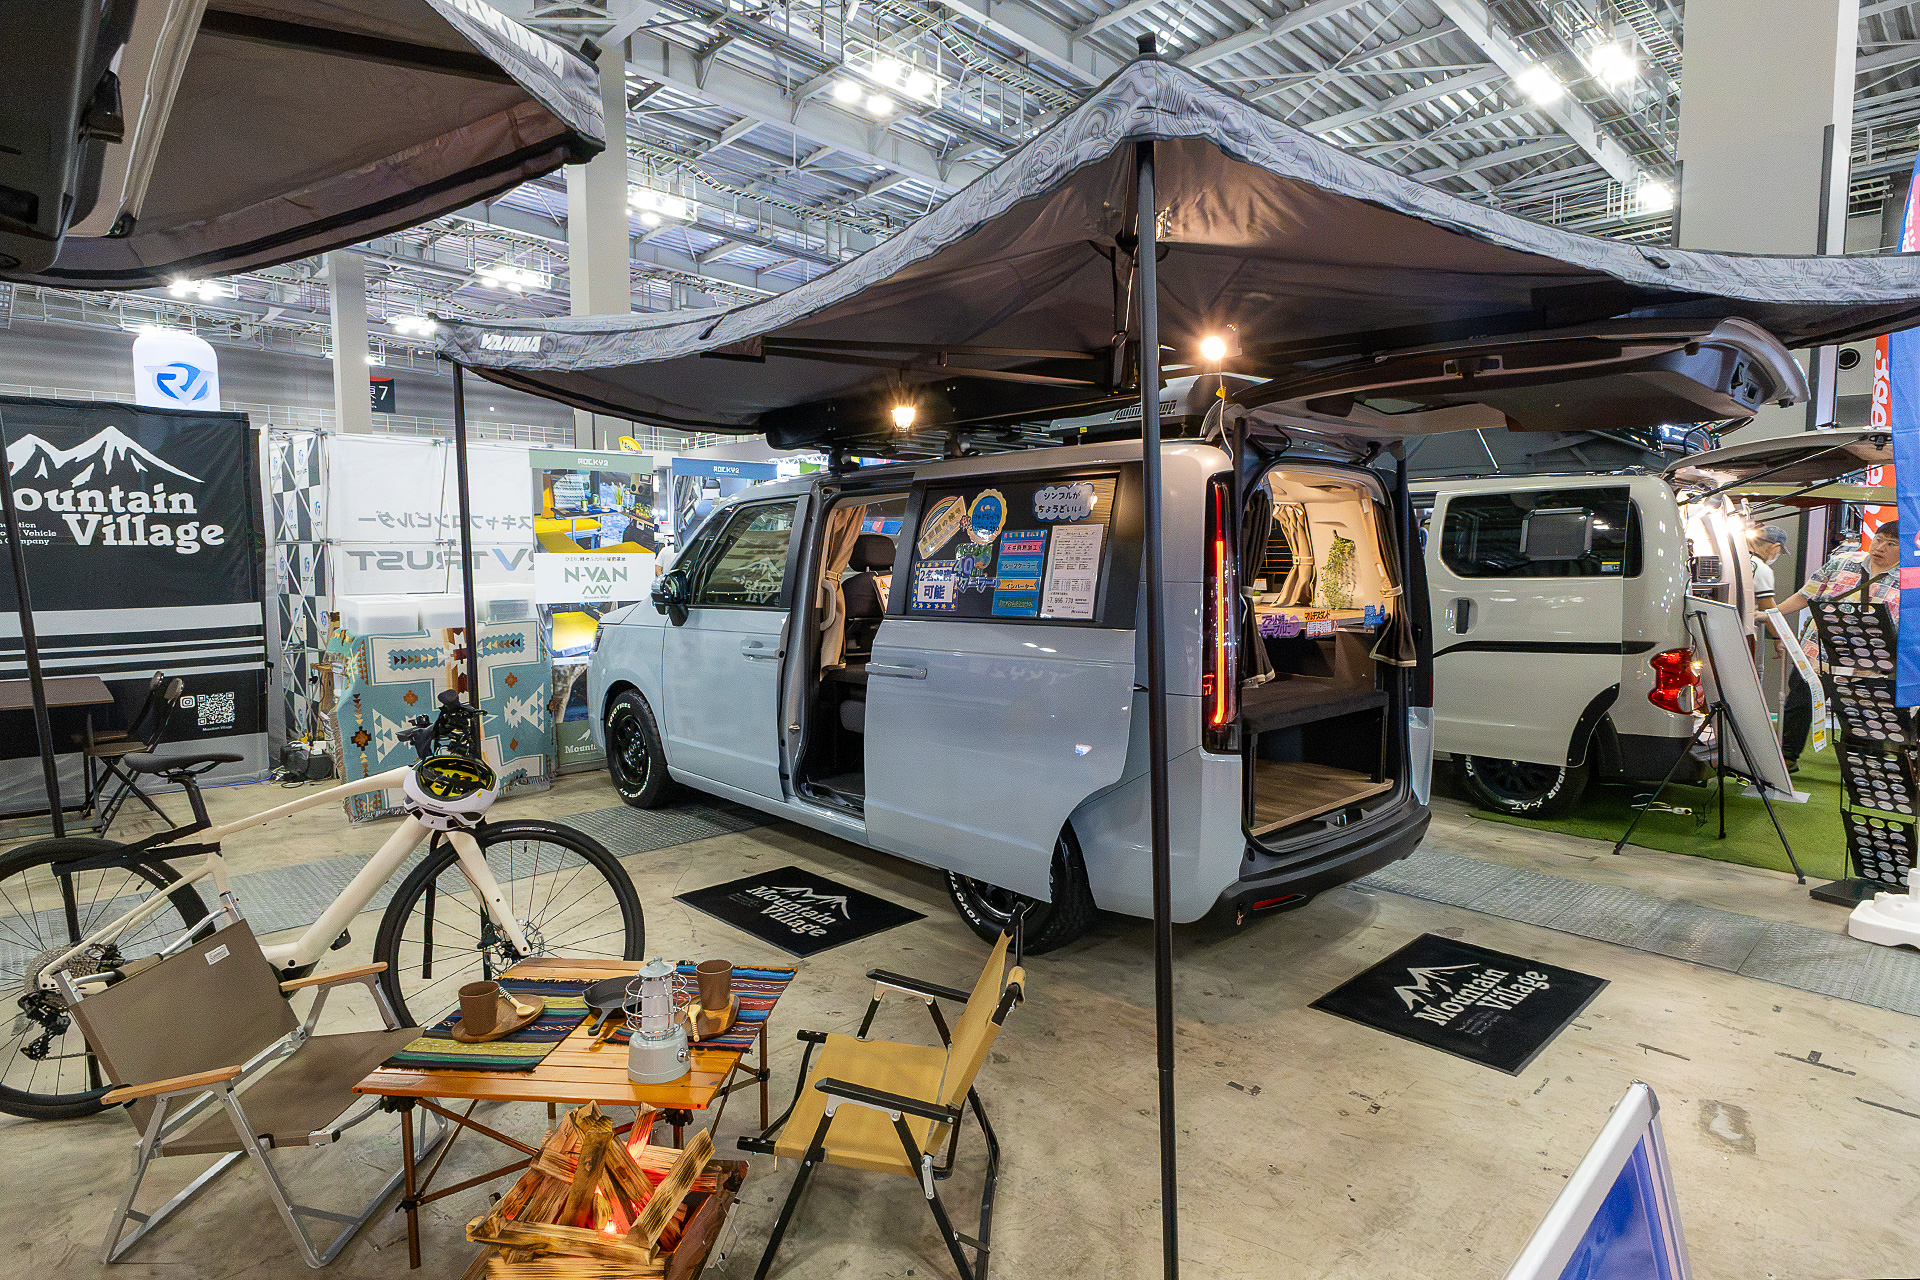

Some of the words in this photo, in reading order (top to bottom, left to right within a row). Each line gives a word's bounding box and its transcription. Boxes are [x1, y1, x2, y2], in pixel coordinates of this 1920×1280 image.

[480, 334, 542, 352] YAKIMA
[0, 483, 197, 514] ountain
[1038, 504, 1082, 513] ちょうどいい
[62, 513, 225, 554] Village
[564, 566, 628, 583] N-VAN
[923, 584, 946, 599] 可能
[745, 885, 837, 926] Mountain
[759, 903, 828, 937] Village
[1413, 968, 1510, 1027] Mountain
[1475, 970, 1550, 1011] Village
